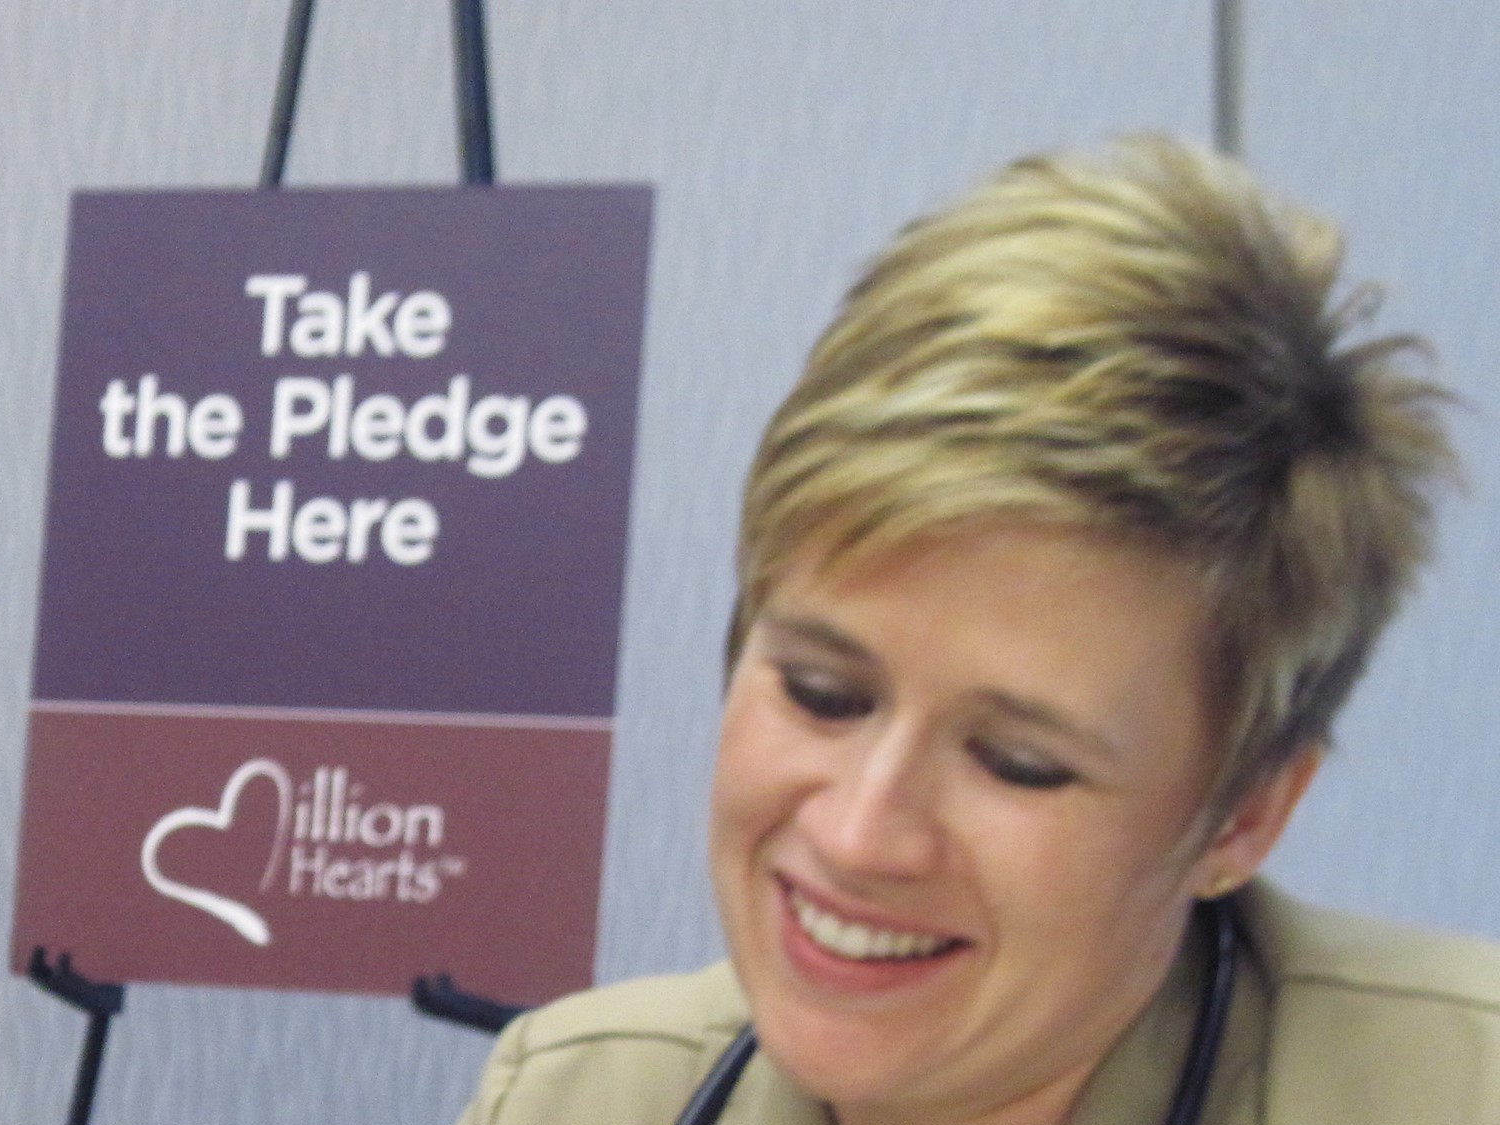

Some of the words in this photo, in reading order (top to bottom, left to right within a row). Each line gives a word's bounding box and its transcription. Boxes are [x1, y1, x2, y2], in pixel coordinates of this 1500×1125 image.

[245, 271, 452, 358] Take
[99, 374, 243, 459] the
[269, 374, 588, 479] Pledge
[225, 479, 439, 565] Here
